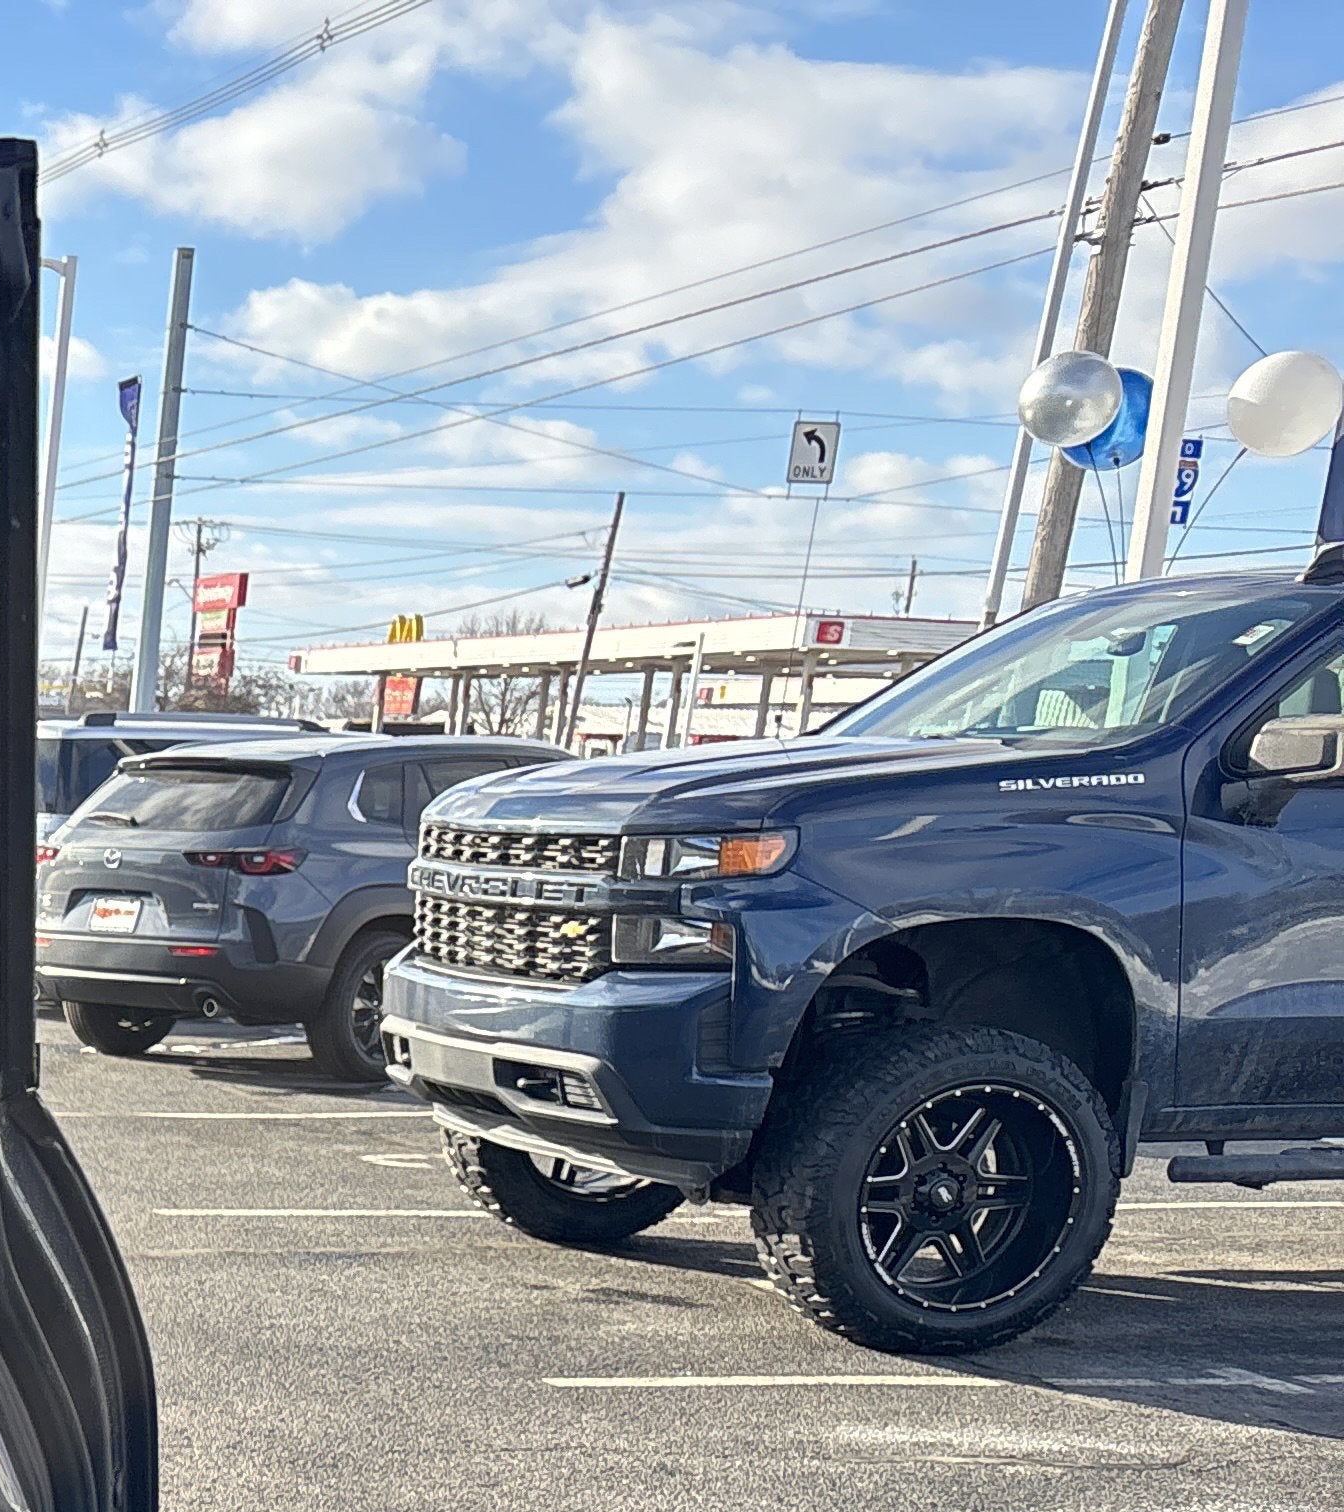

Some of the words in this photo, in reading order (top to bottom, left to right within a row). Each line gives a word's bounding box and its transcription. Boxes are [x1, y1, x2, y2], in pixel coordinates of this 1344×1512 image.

[792, 465, 827, 479] ONLY
[998, 772, 1146, 792] SILVERADO
[410, 867, 599, 903] CHEVROLET
